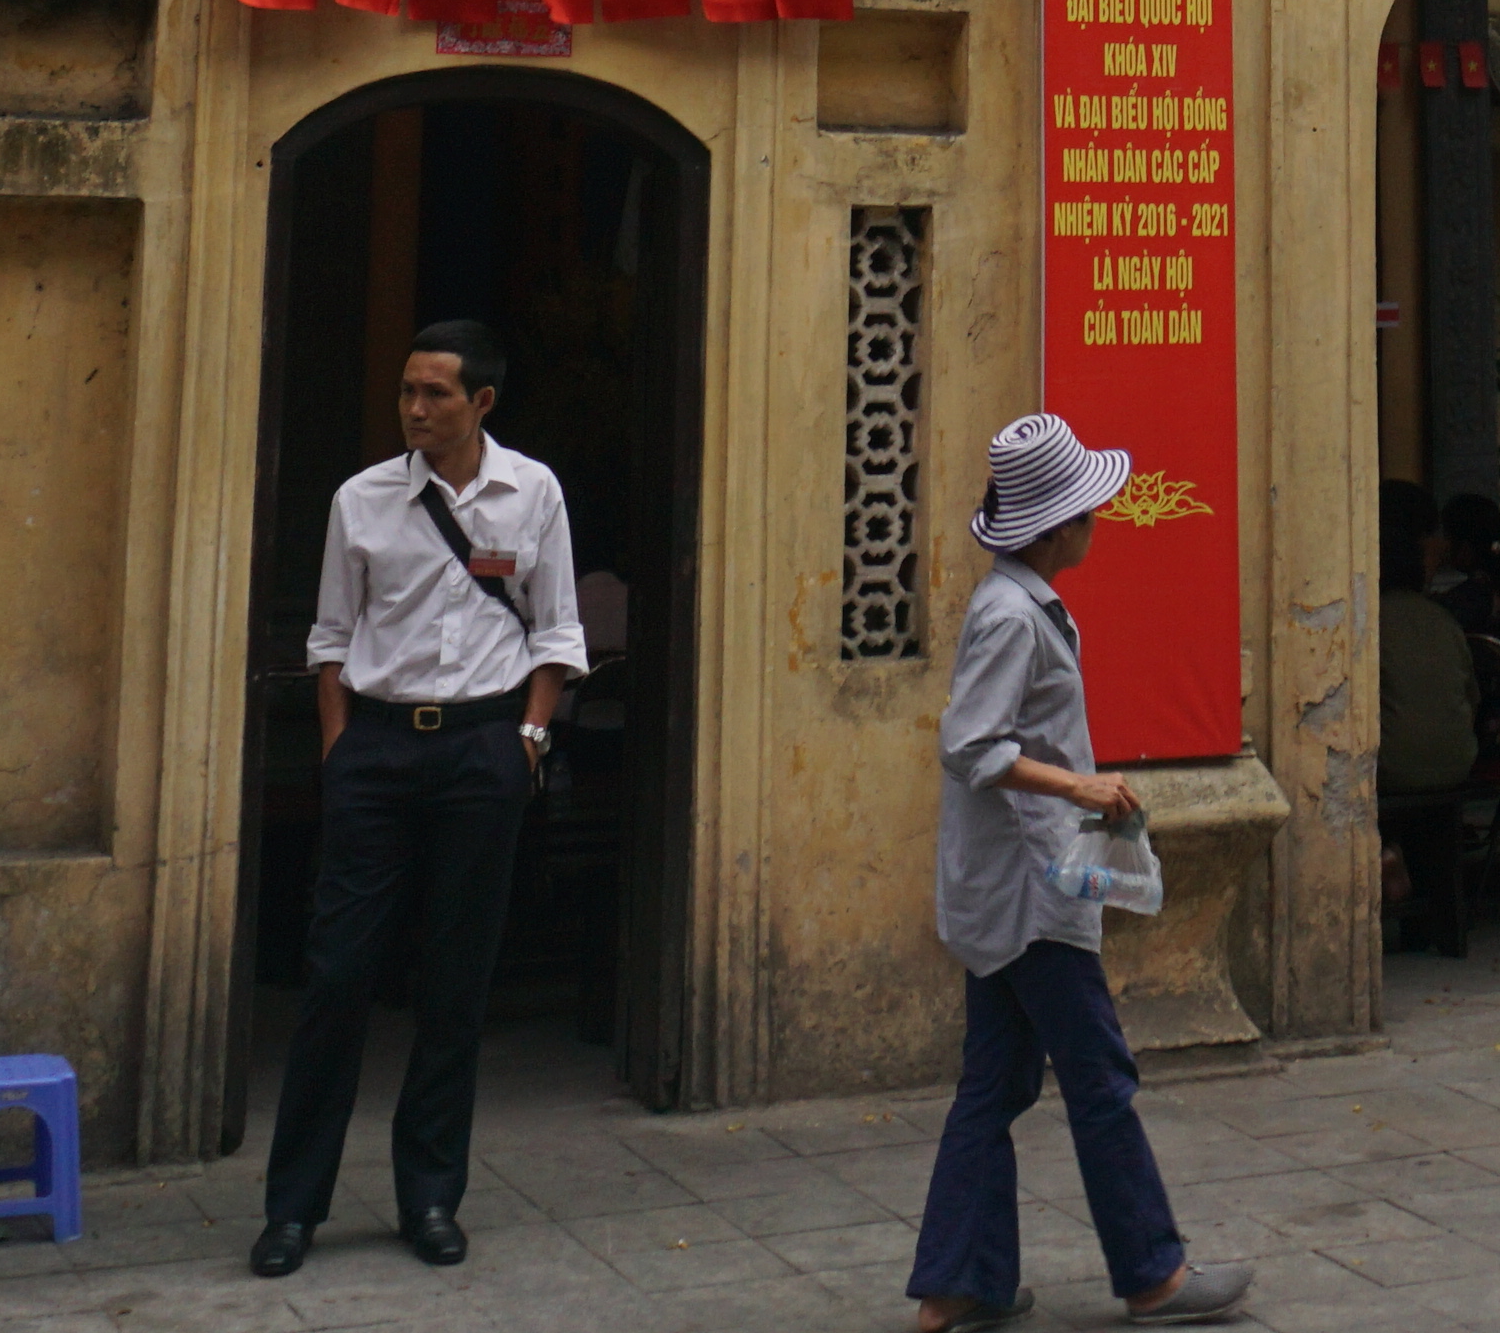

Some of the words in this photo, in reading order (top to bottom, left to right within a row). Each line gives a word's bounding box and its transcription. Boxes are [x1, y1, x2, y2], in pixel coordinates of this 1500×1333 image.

[1103, 38, 1148, 77] KHÓA
[1151, 43, 1178, 78] XIV
[1053, 87, 1076, 129] VÀ
[1078, 94, 1107, 137] ĐẠI
[1111, 82, 1148, 131] BIỂU
[1152, 91, 1179, 138] HỘI
[1182, 85, 1228, 131] ĐỒNG
[1062, 144, 1109, 183] NHÂN
[1113, 144, 1148, 183] DÂN
[1151, 142, 1184, 184] CÁC
[1187, 138, 1220, 184] CẤP
[1053, 198, 1108, 245] NHIỆM
[1112, 195, 1134, 237] KỲ
[1137, 202, 1177, 237] 2016
[1191, 202, 1229, 237] 2021
[1093, 249, 1114, 291] LÀ
[1117, 249, 1162, 291] NGÀY
[1165, 249, 1193, 298] HỘI
[1083, 301, 1118, 346] CỦA
[1120, 302, 1164, 345] TOÀN
[1168, 303, 1202, 345] DÂN
